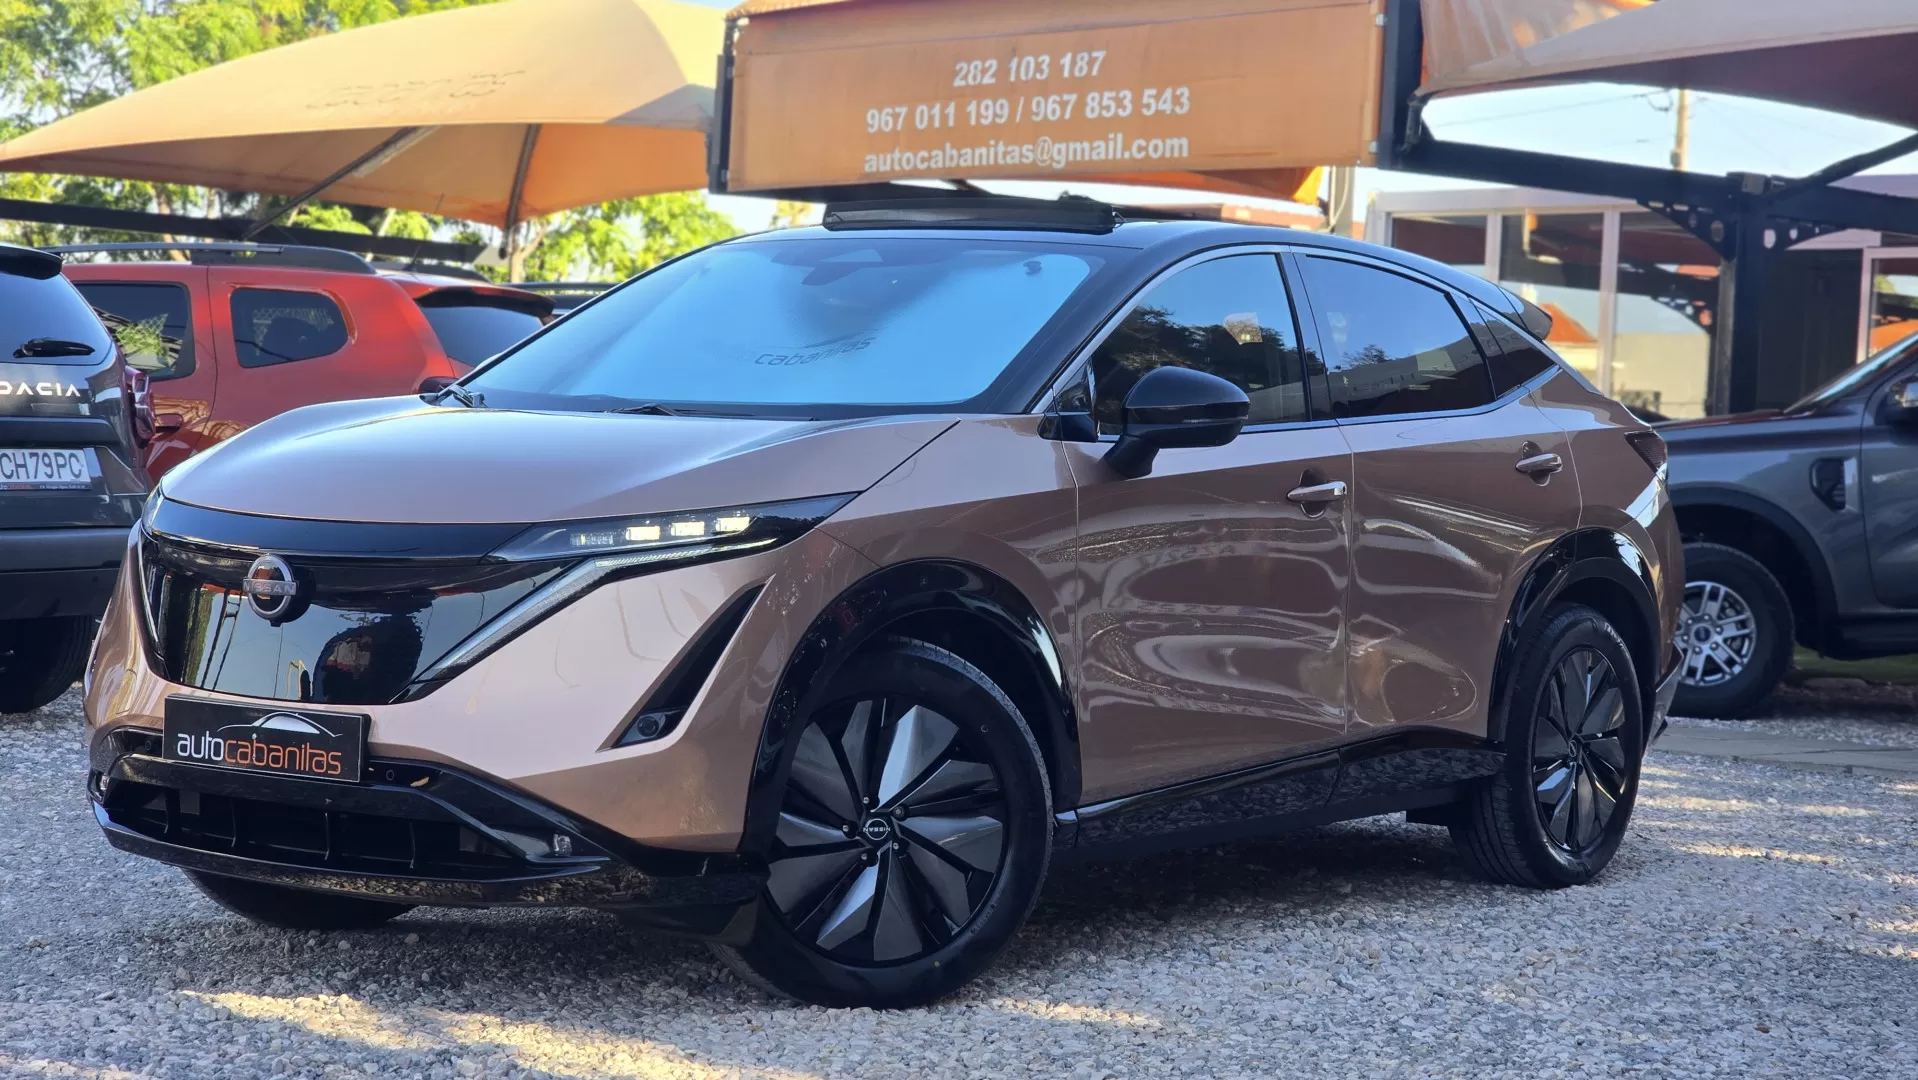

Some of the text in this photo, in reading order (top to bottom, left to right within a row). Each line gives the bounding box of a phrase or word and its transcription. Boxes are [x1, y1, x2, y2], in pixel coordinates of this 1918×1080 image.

[952, 50, 1106, 87] 282 103 187
[866, 86, 1191, 133] 967 011 199 / 967 853 543
[863, 133, 1189, 173] autocabanitas@gmail.com
[0, 381, 81, 397] DACIA
[0, 451, 83, 480] CH79PC
[243, 580, 296, 595] NISSAN
[177, 730, 342, 775] autocabanitas
